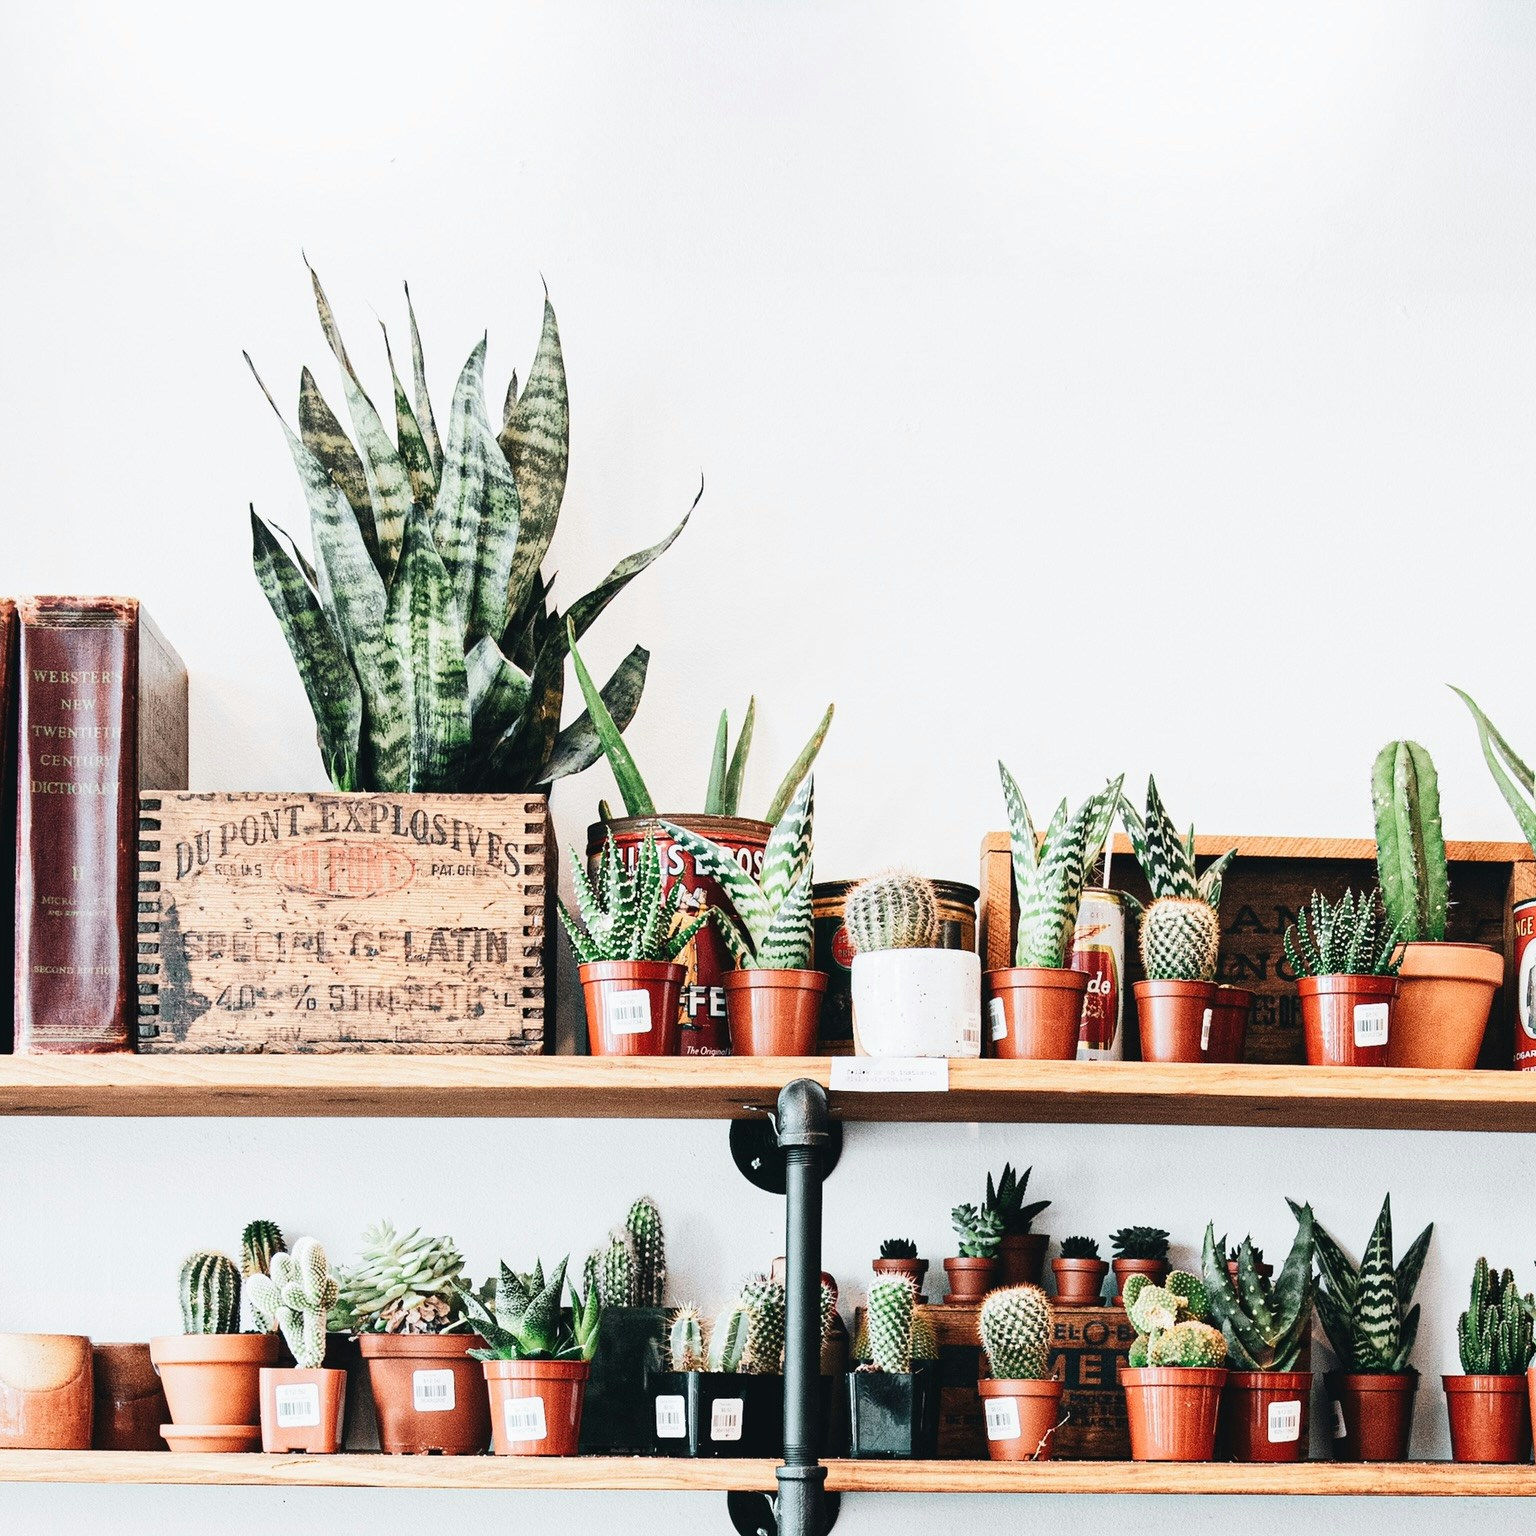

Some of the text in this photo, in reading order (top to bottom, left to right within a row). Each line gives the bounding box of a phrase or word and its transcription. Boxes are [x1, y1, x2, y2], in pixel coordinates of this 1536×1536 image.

[61, 699, 97, 710] NEW
[32, 725, 121, 739] TWENTIETH
[40, 754, 113, 767] CENTURY
[30, 781, 121, 795] DICTIONARY
[219, 804, 305, 858] PONT
[319, 800, 521, 879] EXPLOSIVES
[181, 930, 327, 964] SPECIAL
[33, 966, 74, 974] SECOND
[686, 1046, 728, 1057] The Original
